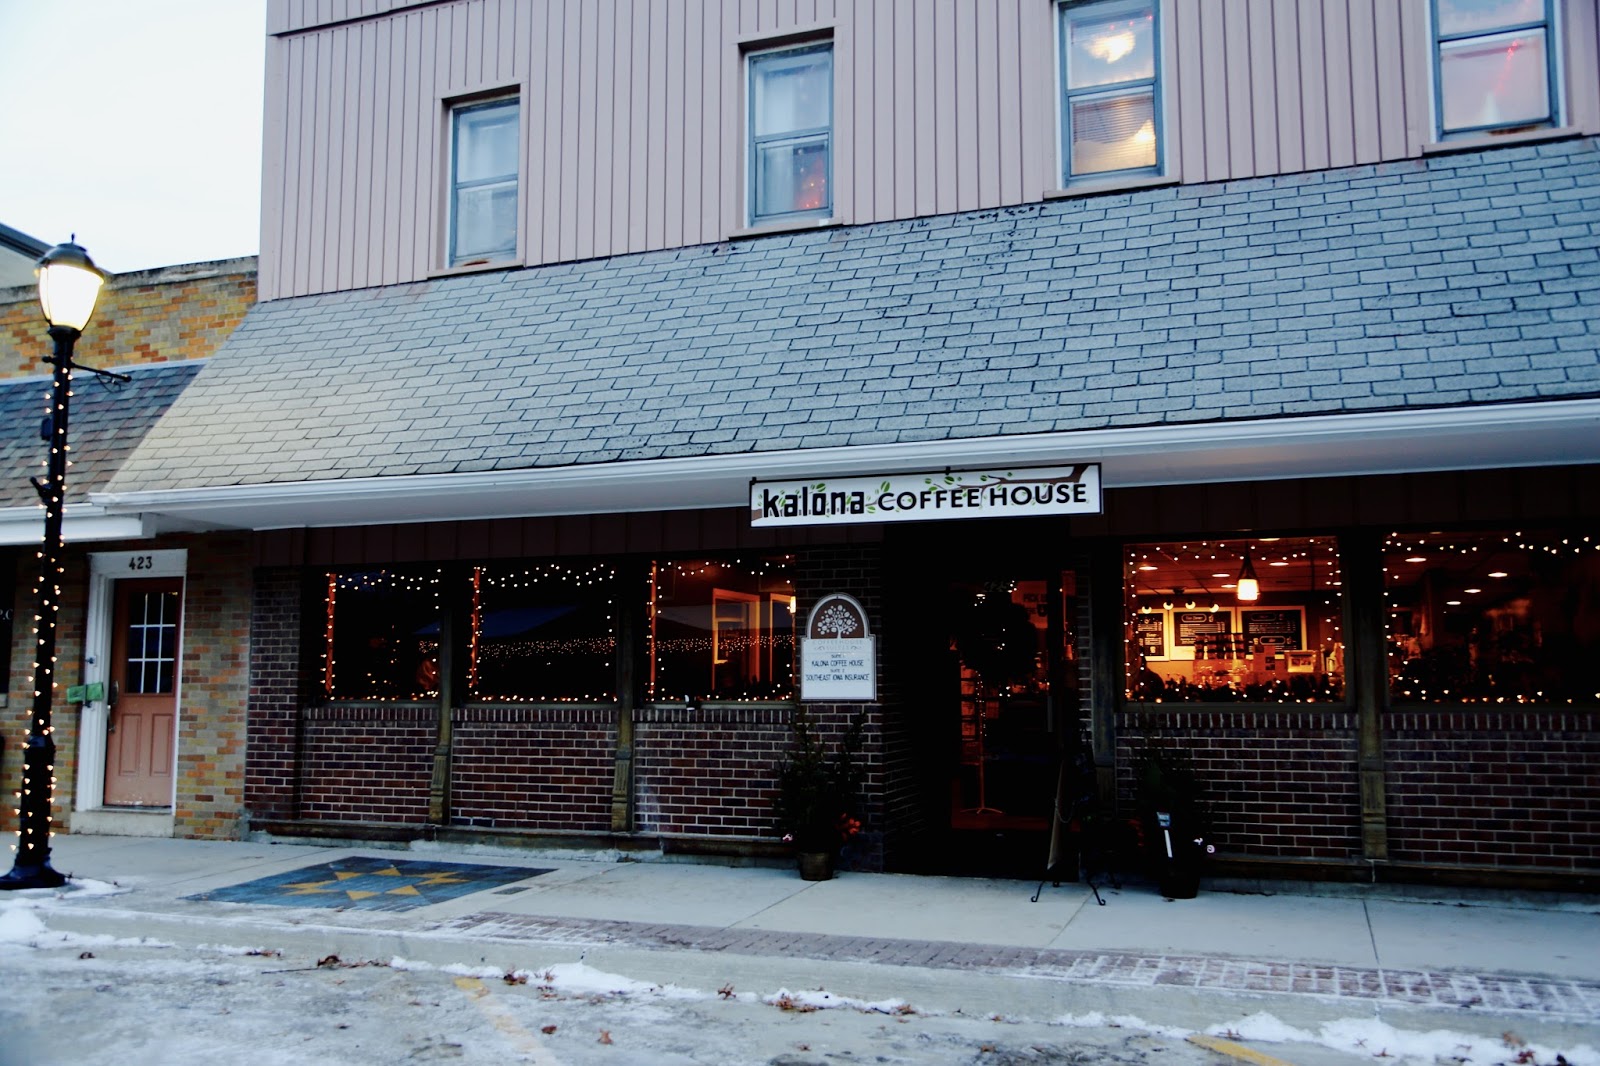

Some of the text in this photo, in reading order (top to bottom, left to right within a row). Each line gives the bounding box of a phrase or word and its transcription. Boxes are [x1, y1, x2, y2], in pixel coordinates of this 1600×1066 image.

[763, 483, 1087, 518] kalona COFFEE HOUSE
[128, 556, 153, 570] 423
